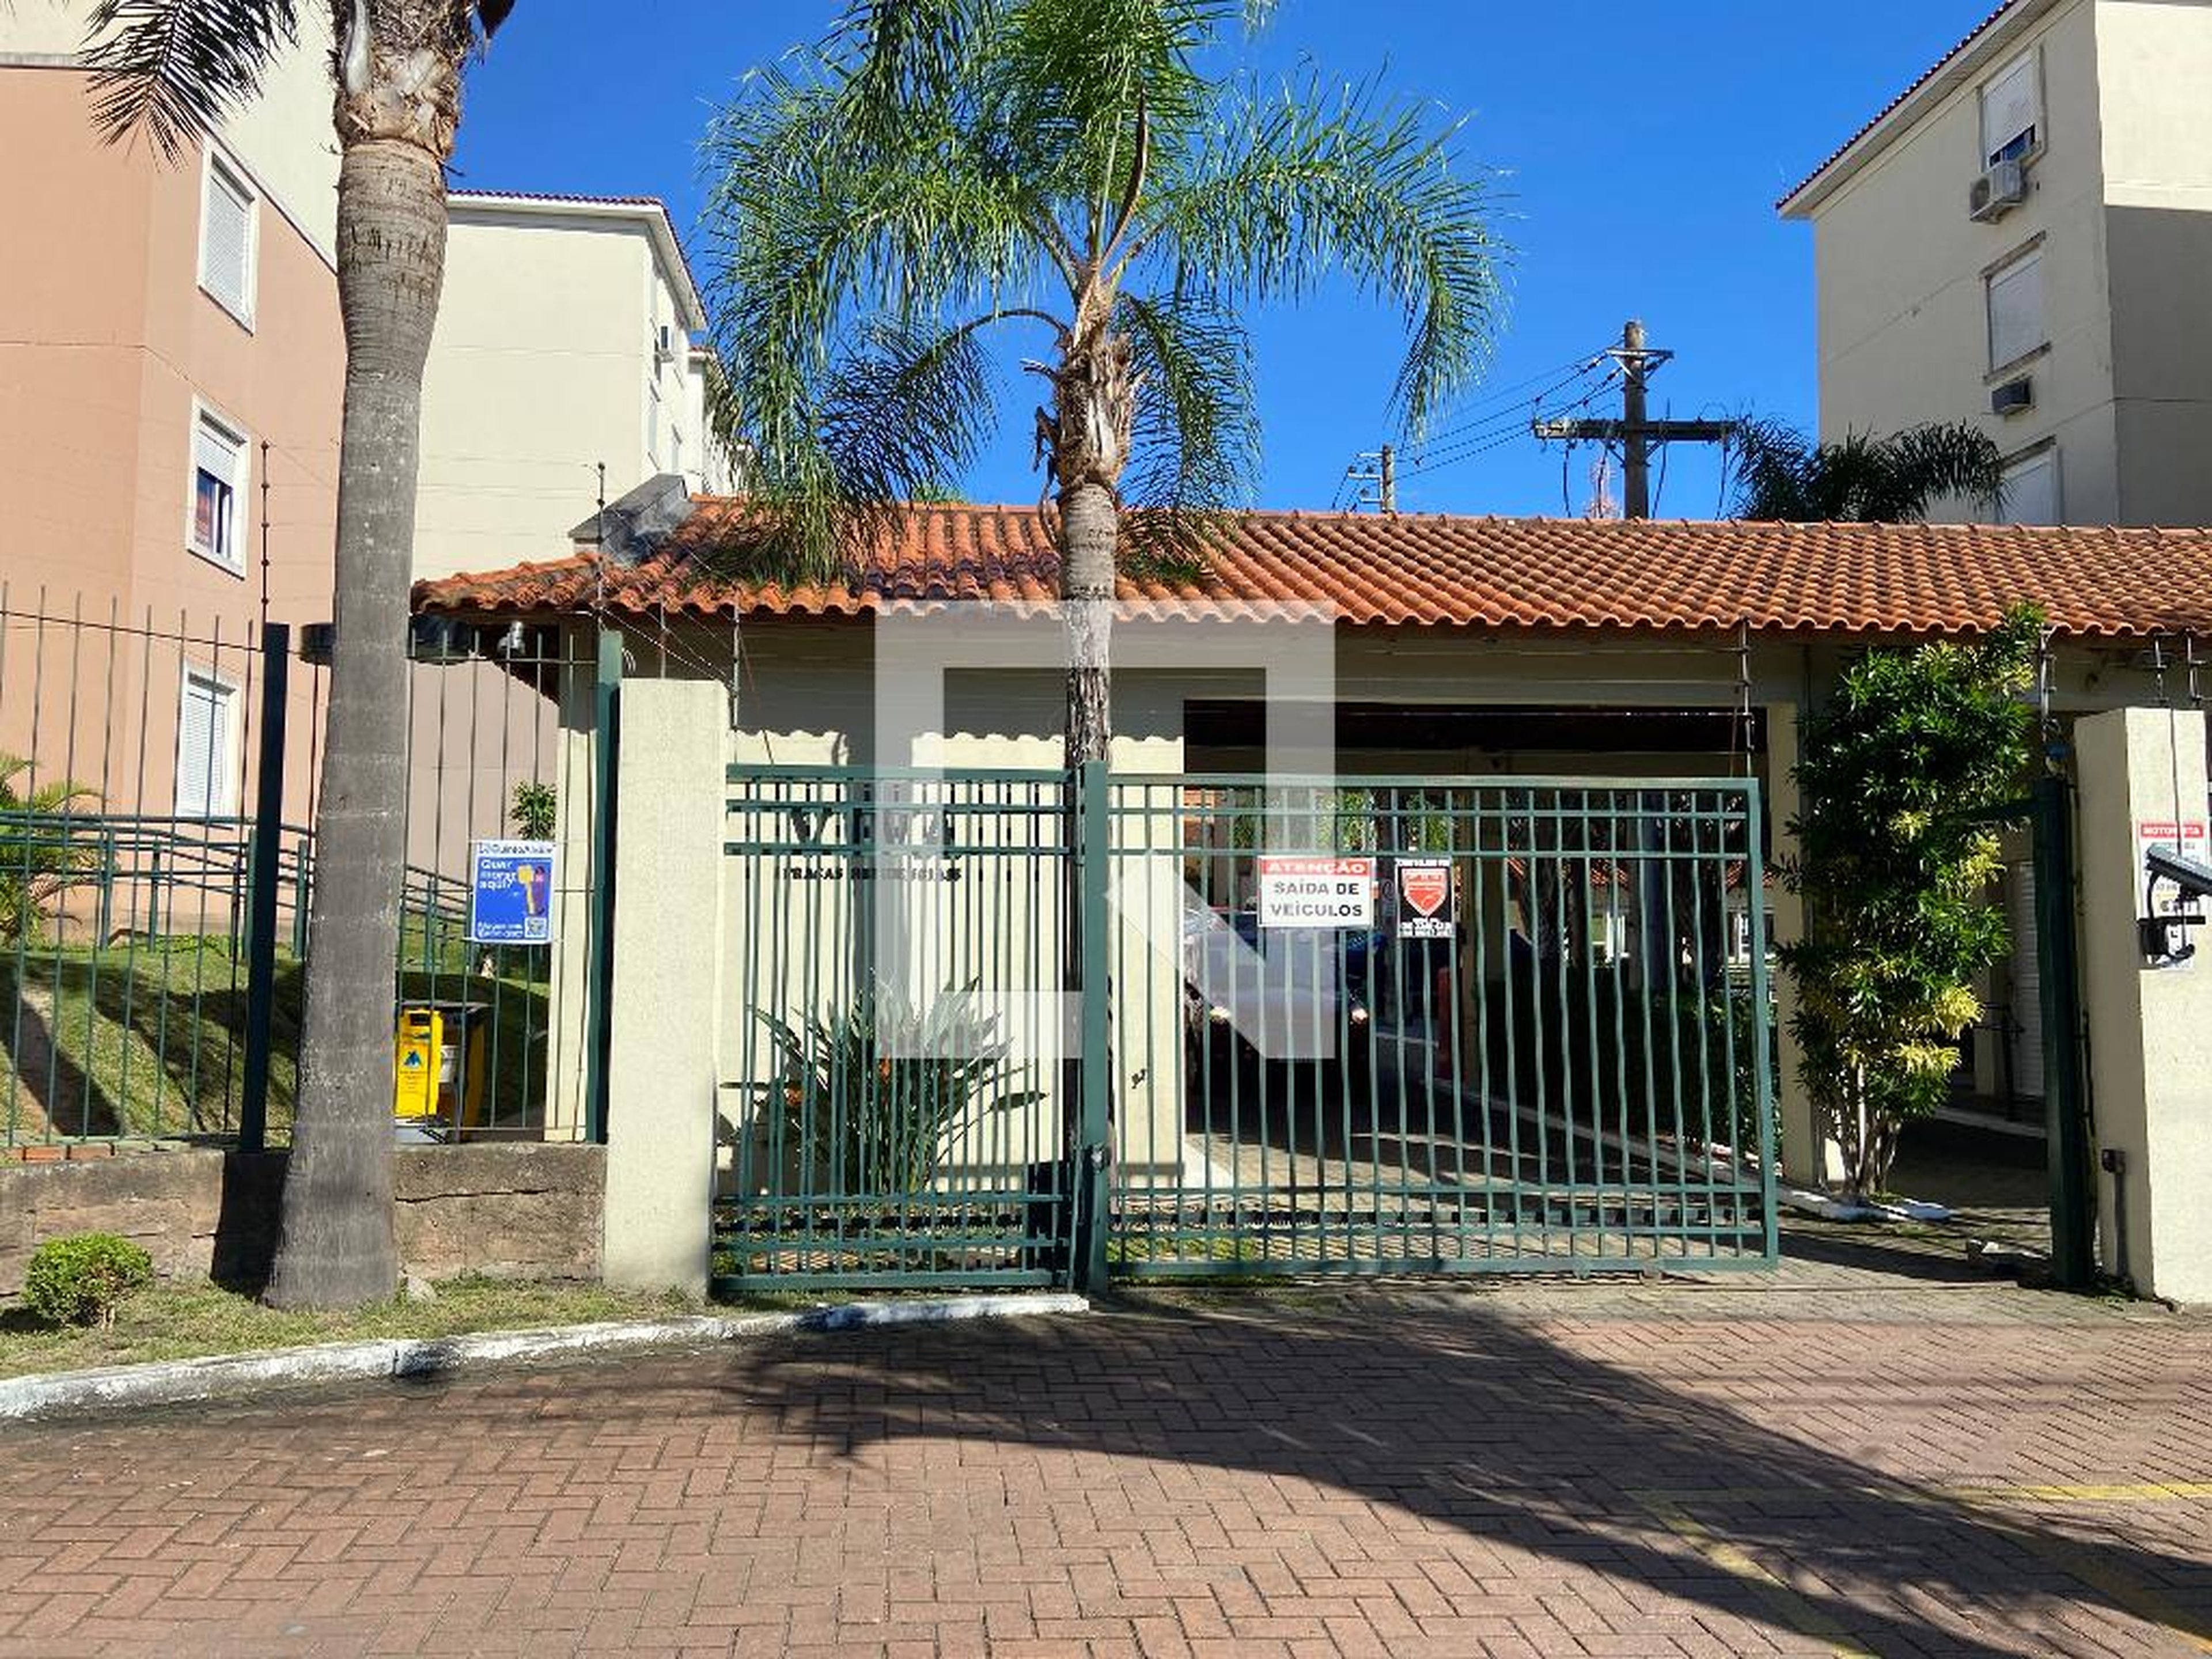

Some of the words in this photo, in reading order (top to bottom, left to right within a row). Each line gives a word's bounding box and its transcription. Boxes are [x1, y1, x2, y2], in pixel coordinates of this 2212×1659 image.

[1268, 860, 1366, 875] ATENÇÃO
[1274, 878, 1329, 895] SAÍDA
[1336, 882, 1359, 895] DE
[1271, 900, 1362, 917] VEÍCULOS
